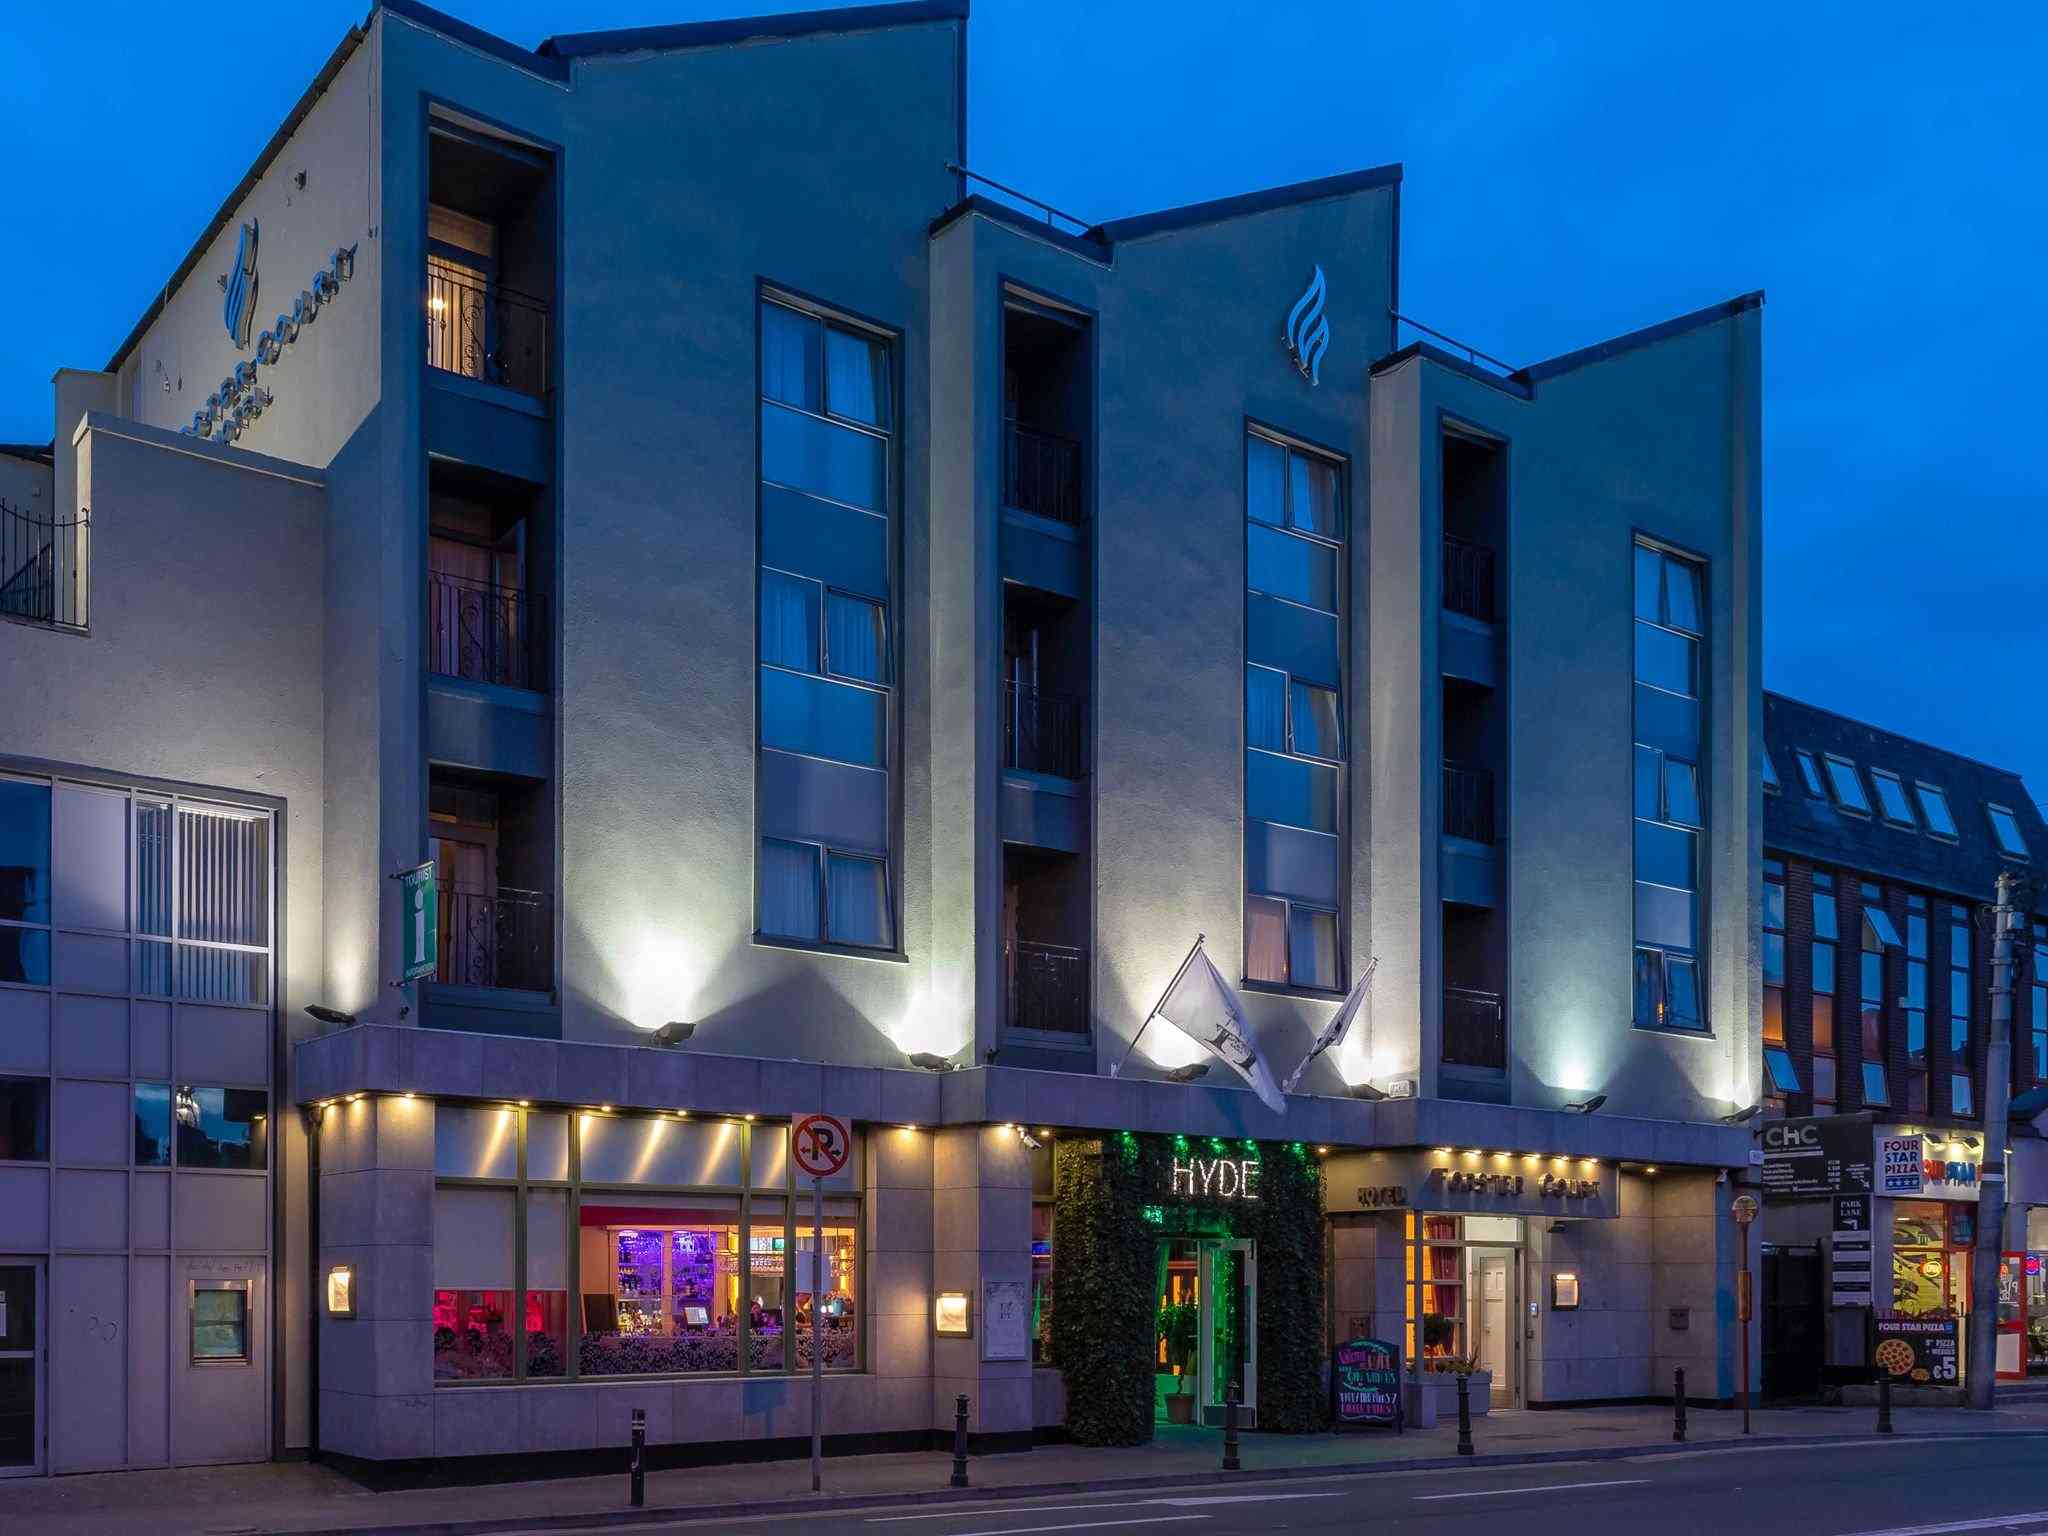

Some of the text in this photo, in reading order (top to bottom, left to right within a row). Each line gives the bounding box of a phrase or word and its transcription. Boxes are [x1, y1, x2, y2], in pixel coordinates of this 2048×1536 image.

[1884, 1140, 1919, 1152] FOUR
[1885, 1152, 1918, 1163] STAR
[1885, 1163, 1919, 1174] PIZZA
[1172, 1157, 1259, 1198] HYDE
[1840, 1200, 1861, 1208] PARK
[1840, 1209, 1861, 1217] LANE
[1878, 1322, 1944, 1331] FOUR STAR PIZZA
[1933, 1356, 1956, 1379] €5
